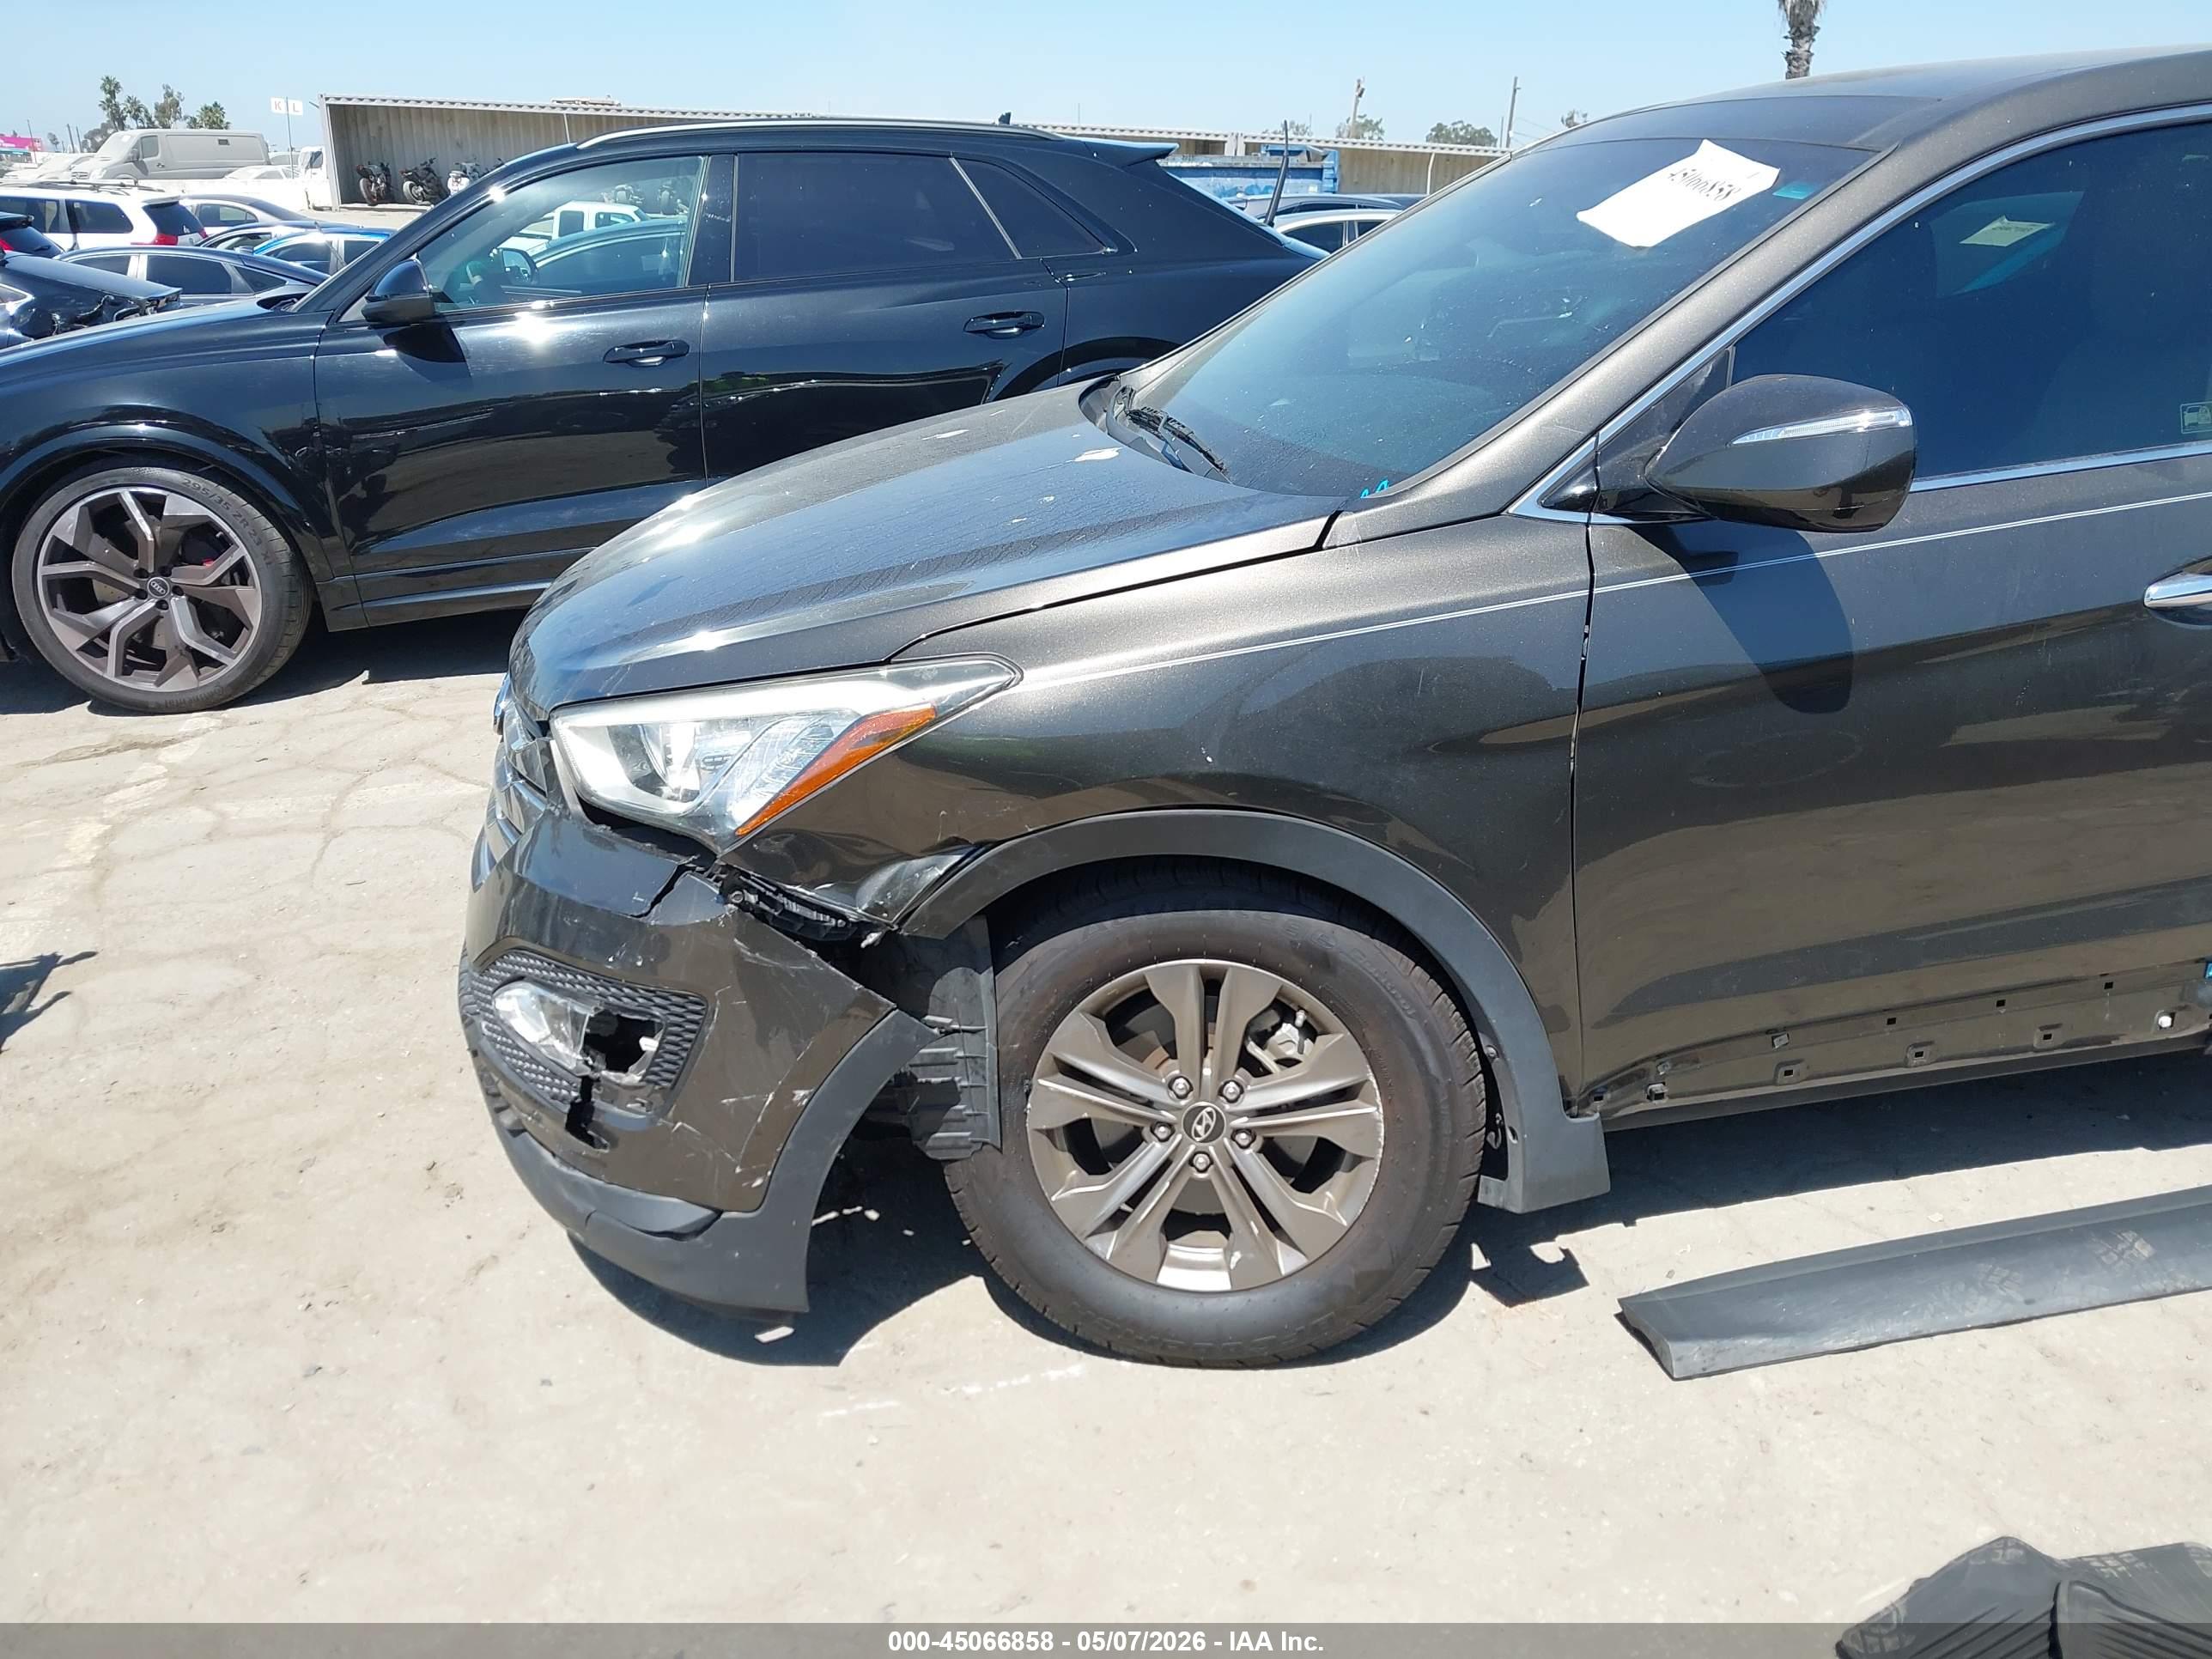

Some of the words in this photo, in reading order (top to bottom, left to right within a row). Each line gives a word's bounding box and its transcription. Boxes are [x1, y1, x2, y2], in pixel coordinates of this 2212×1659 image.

[274, 100, 283, 111] K
[292, 102, 301, 112] L
[181, 478, 232, 511] 295/35
[232, 507, 250, 529] ZR
[247, 528, 262, 546] 23
